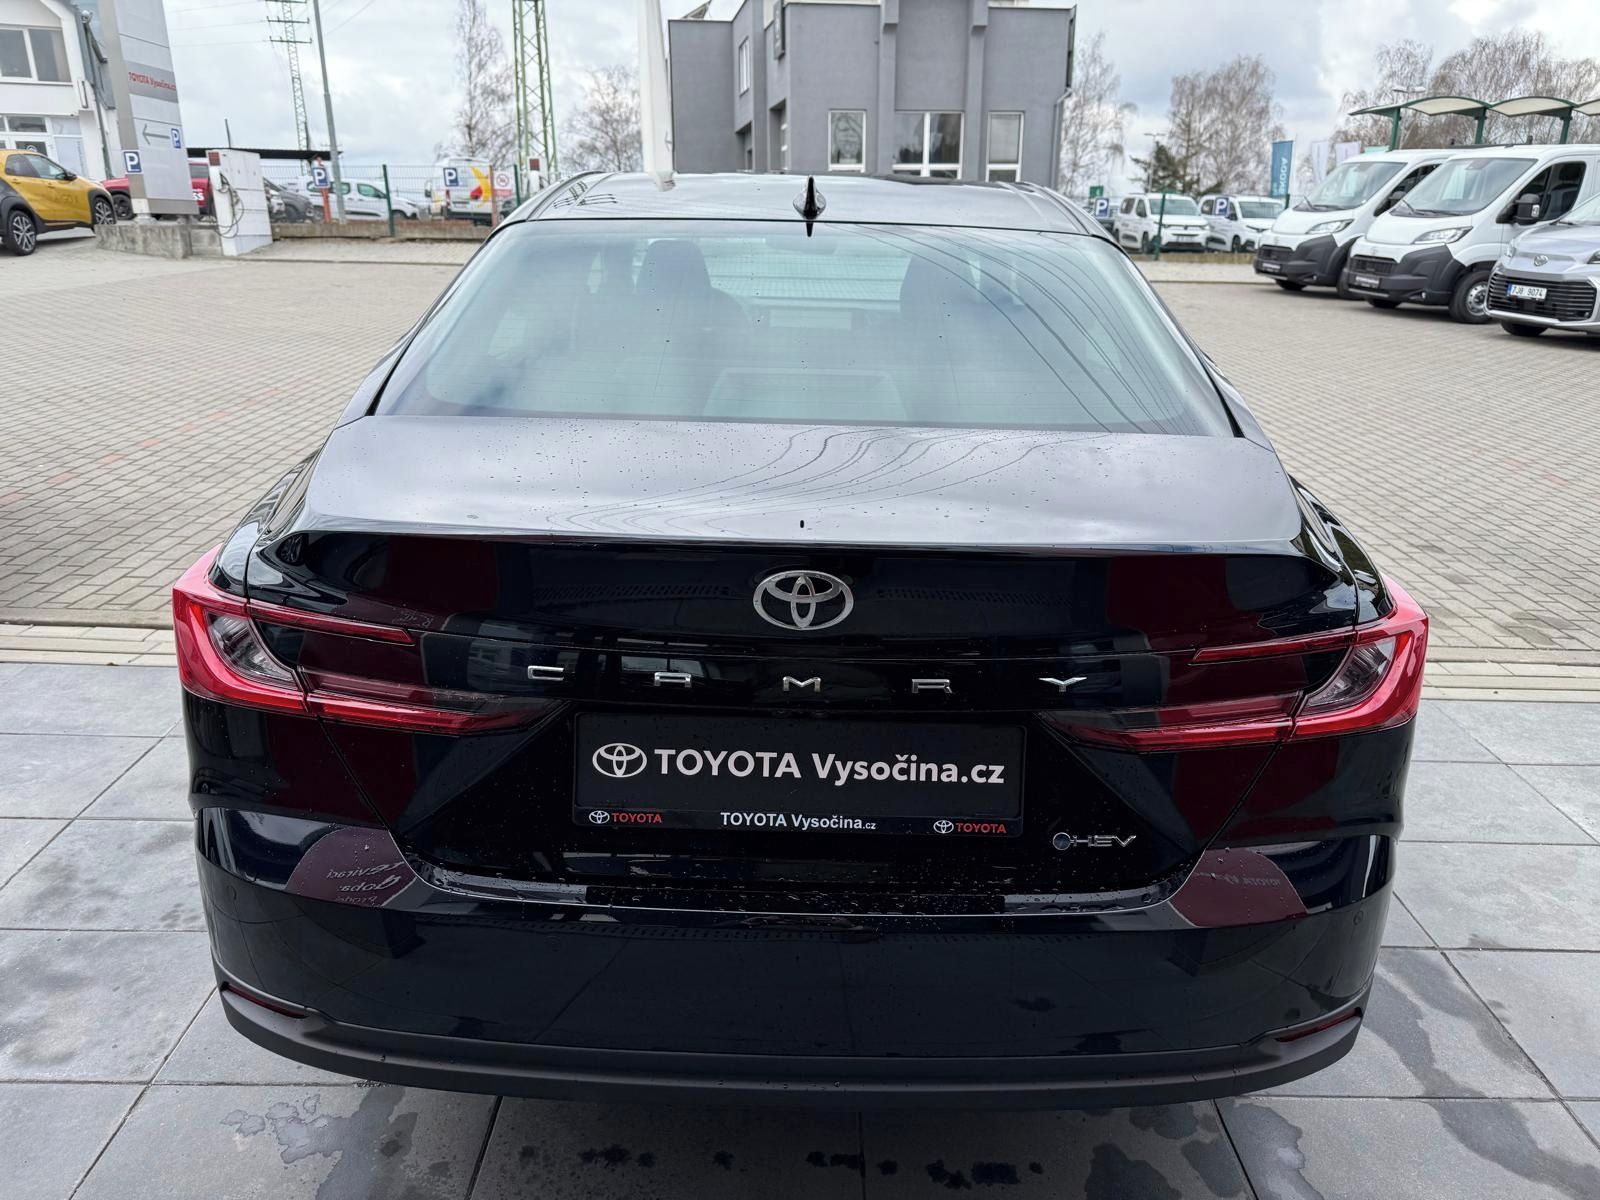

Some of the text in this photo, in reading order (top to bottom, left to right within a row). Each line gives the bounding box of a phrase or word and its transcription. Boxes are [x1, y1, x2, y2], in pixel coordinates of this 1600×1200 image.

[125, 153, 139, 172] P
[313, 168, 326, 186] P
[444, 168, 457, 186] P
[1096, 199, 1108, 216] P
[1215, 198, 1227, 216] P
[654, 748, 1005, 787] TOYOTA Vysočina.cz
[611, 812, 663, 824] TOYOTA
[720, 811, 787, 827] TOYOTA
[955, 822, 1007, 834] TOYOTA
